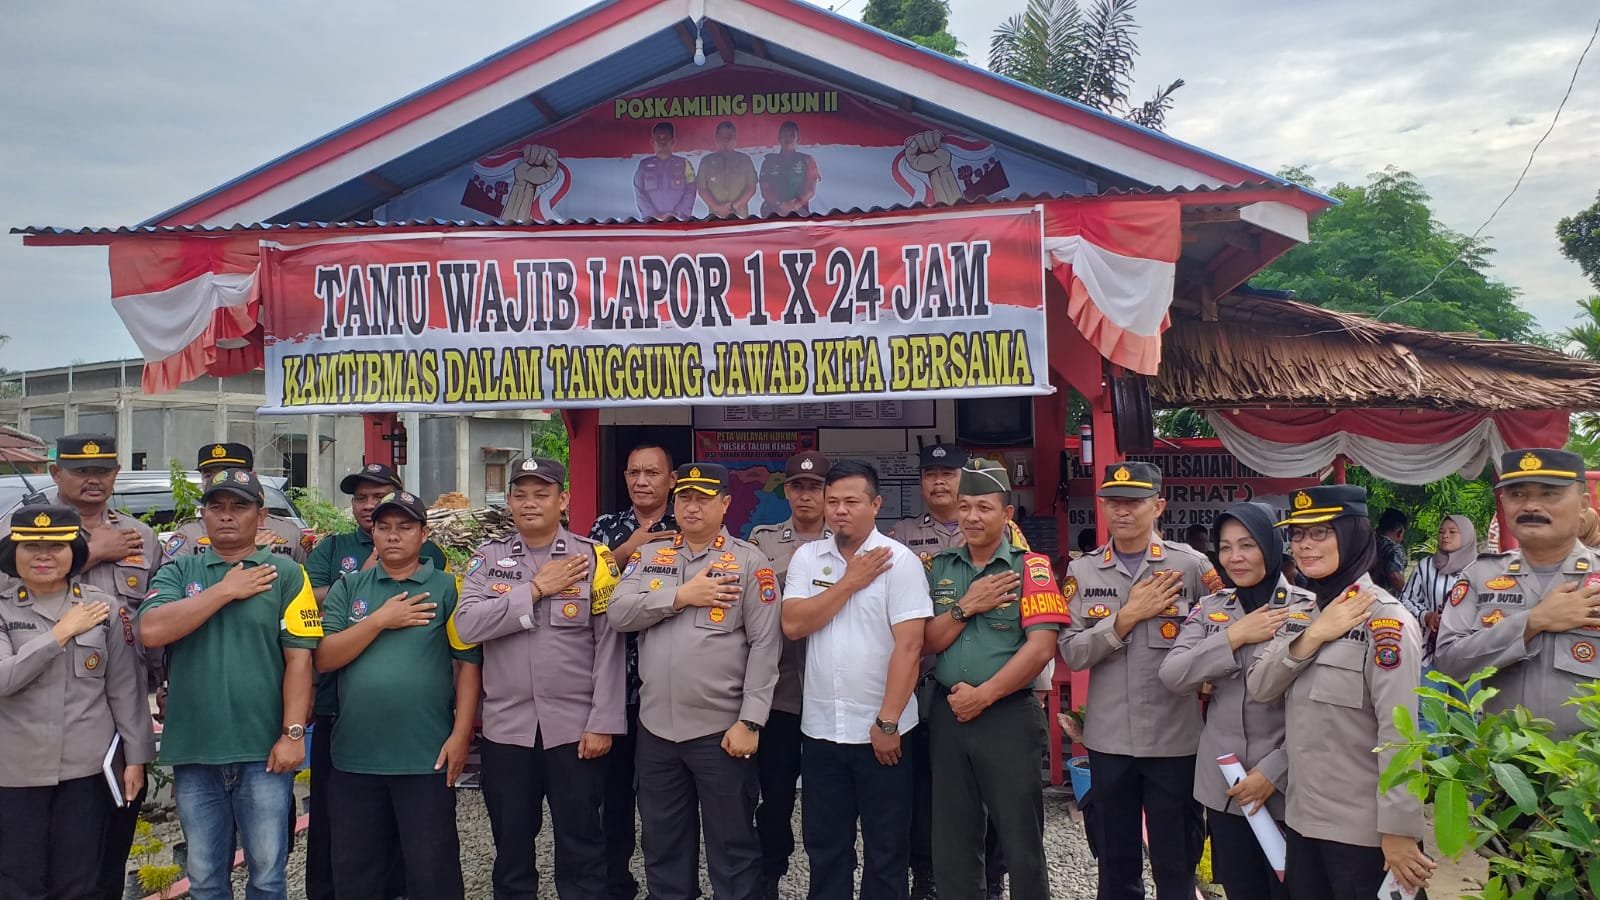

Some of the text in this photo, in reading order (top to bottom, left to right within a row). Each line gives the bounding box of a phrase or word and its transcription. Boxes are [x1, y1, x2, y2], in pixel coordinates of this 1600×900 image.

[615, 91, 838, 119] POSKAMLING DUSUN II
[315, 240, 991, 340] TAMU WAJIB LAPOR 1 X 24 JAM
[281, 329, 1035, 407] KAMTIBMAS DALAM TANGGUNG JAWAB KITA BERSAMA
[716, 431, 798, 441] PETA WILAYAH HUKUM
[719, 442, 747, 451] POLSEK
[1084, 588, 1118, 597] JURNAL
